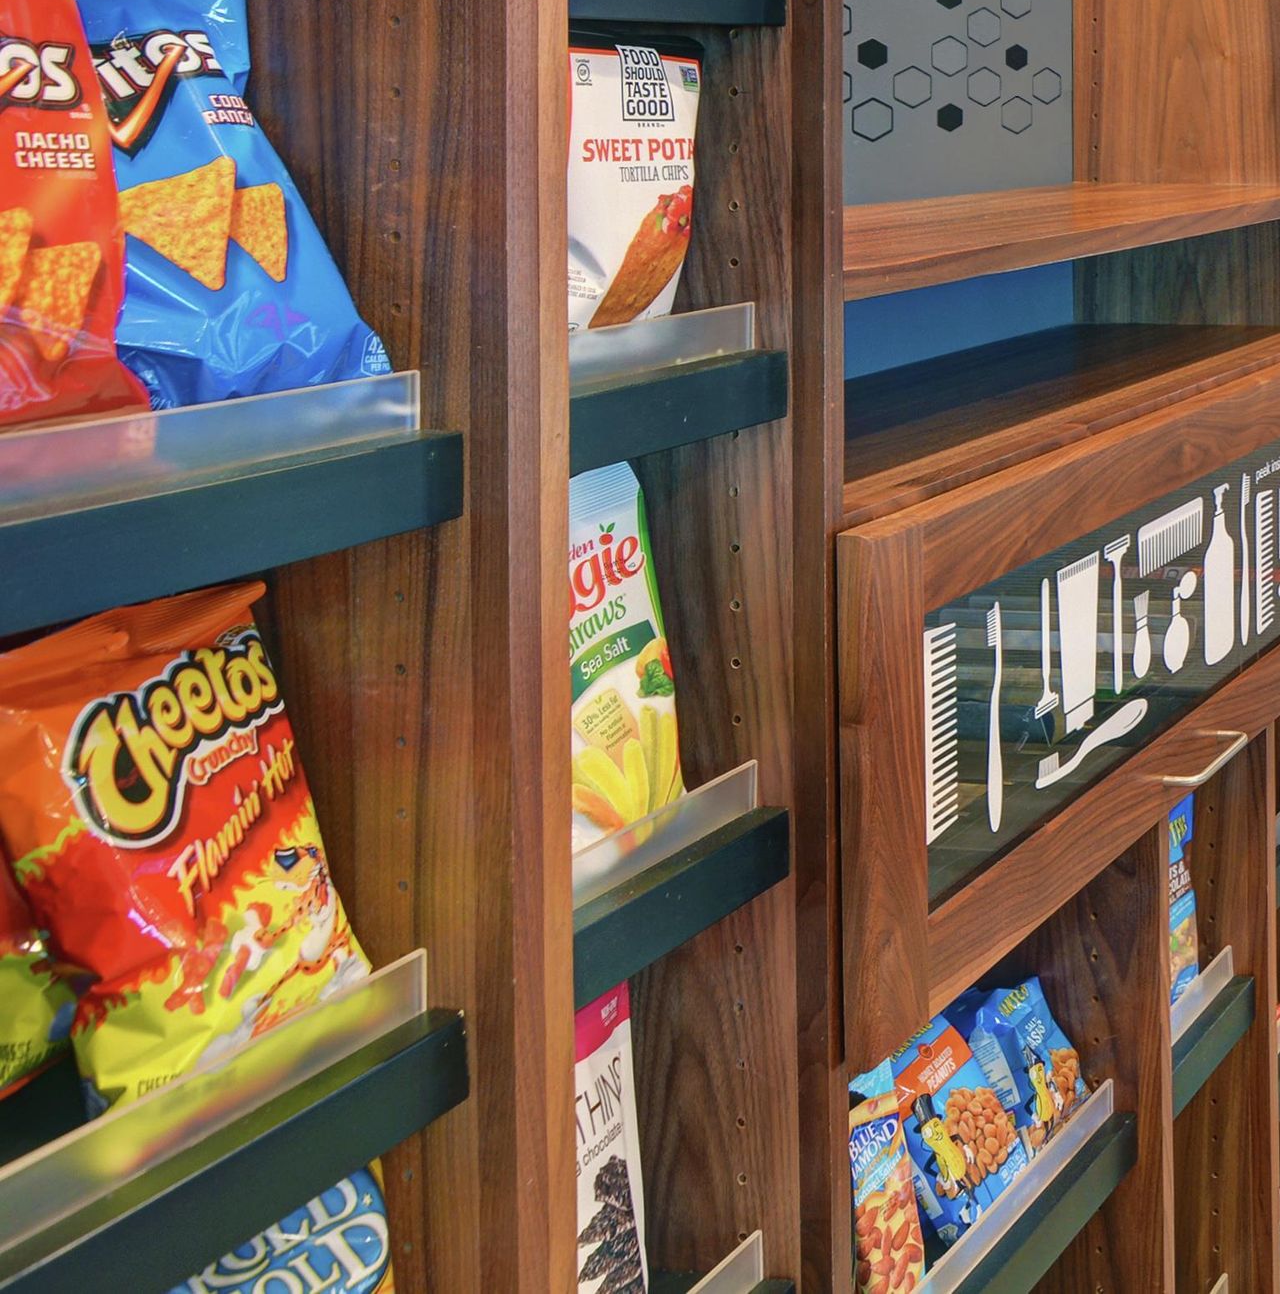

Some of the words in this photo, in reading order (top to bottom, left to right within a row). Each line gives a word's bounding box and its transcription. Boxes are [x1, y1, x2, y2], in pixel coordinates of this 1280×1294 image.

[93, 32, 222, 100] itos
[620, 48, 660, 67] FOOD
[624, 66, 664, 82] SHOULD
[625, 82, 667, 98] TASTE
[626, 99, 669, 116] GOOD
[16, 131, 91, 151] NACHO
[582, 138, 643, 162] SWEET
[15, 150, 96, 170] CHEESE
[619, 166, 660, 183] TORTILLA
[662, 165, 689, 182] CHIPS
[1255, 461, 1271, 484] peek
[570, 540, 595, 562] den
[569, 533, 646, 621] gie
[580, 654, 603, 681] Sea
[604, 636, 631, 660] Salt
[78, 640, 278, 834] Cheetos
[187, 728, 257, 784] Crunchy
[166, 780, 262, 920] Flamin'
[260, 738, 295, 801] Hot
[849, 1122, 879, 1163] BLUE
[852, 1117, 898, 1181] IAMOND
